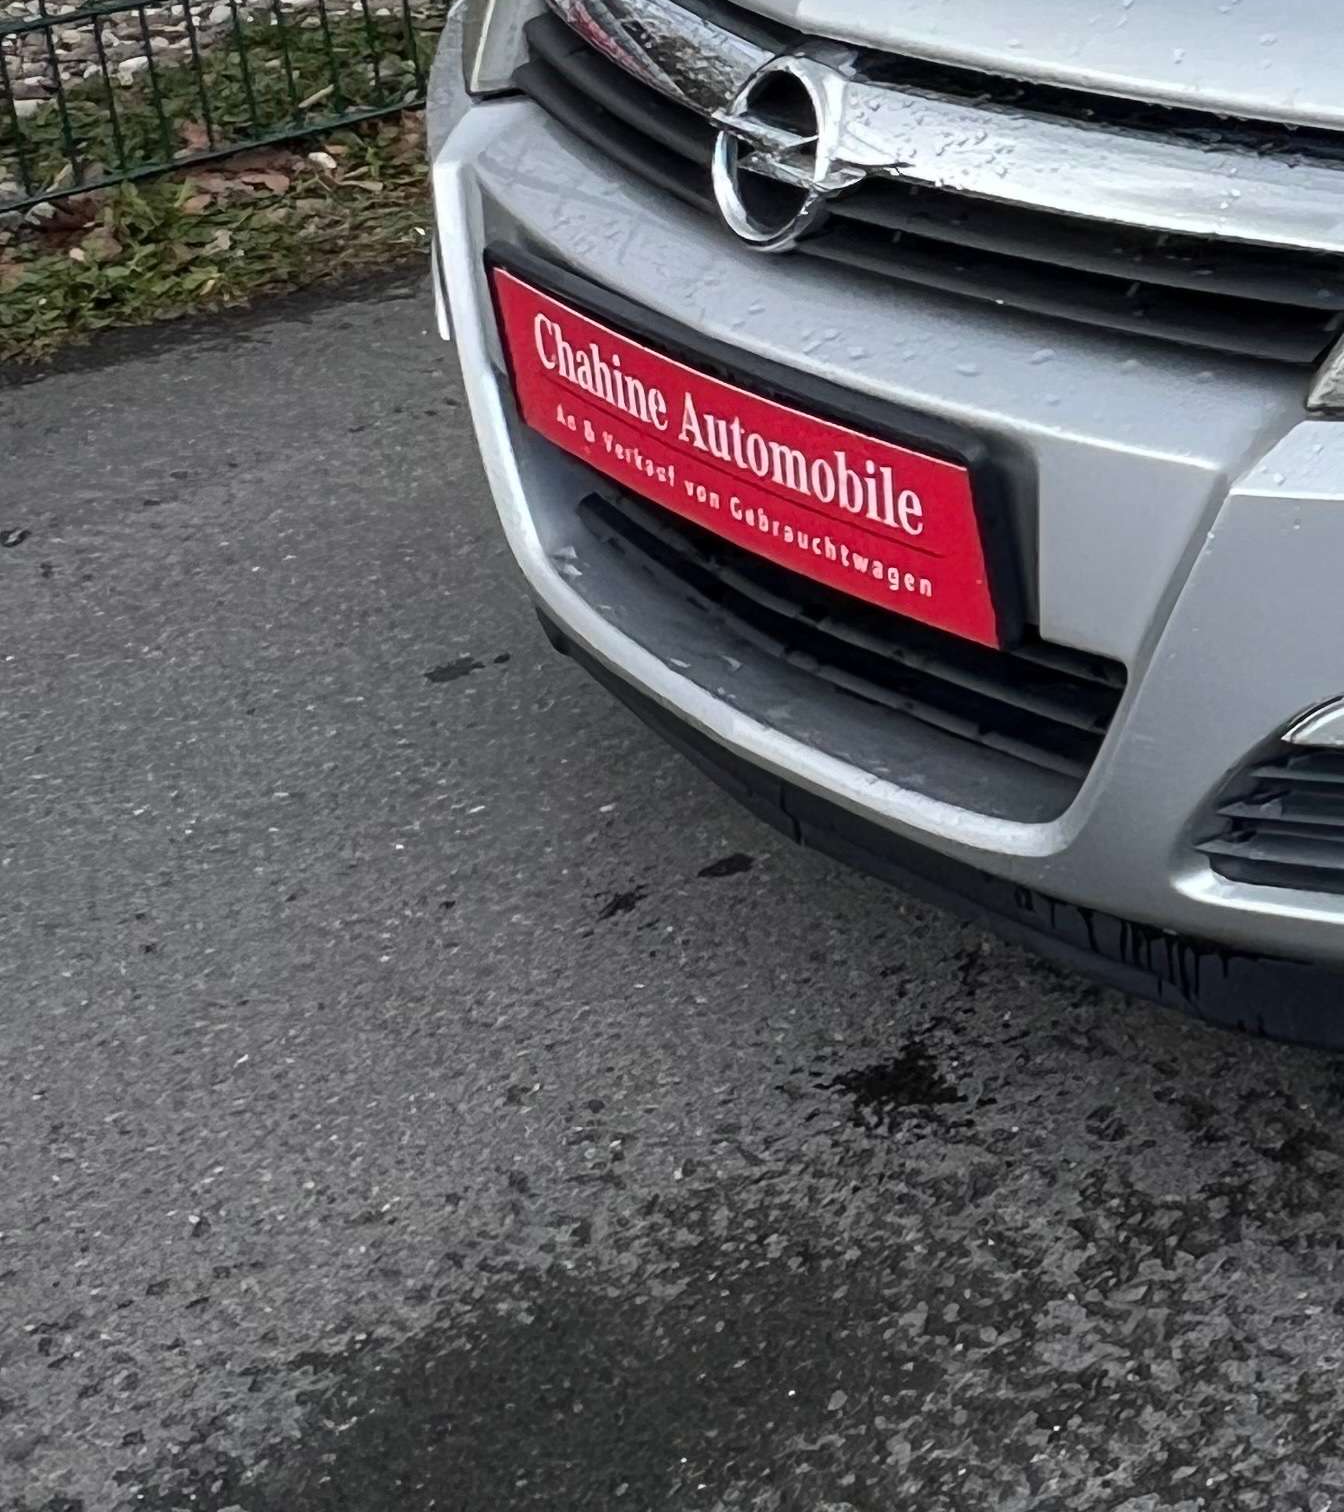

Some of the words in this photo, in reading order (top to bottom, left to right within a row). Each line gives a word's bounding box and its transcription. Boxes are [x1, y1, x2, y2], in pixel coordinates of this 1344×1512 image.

[533, 311, 669, 431] Chahine
[677, 391, 925, 536] Automobile
[602, 431, 675, 488] Verkauf
[684, 479, 720, 510] von
[730, 497, 934, 598] Gebrauchtwagen
